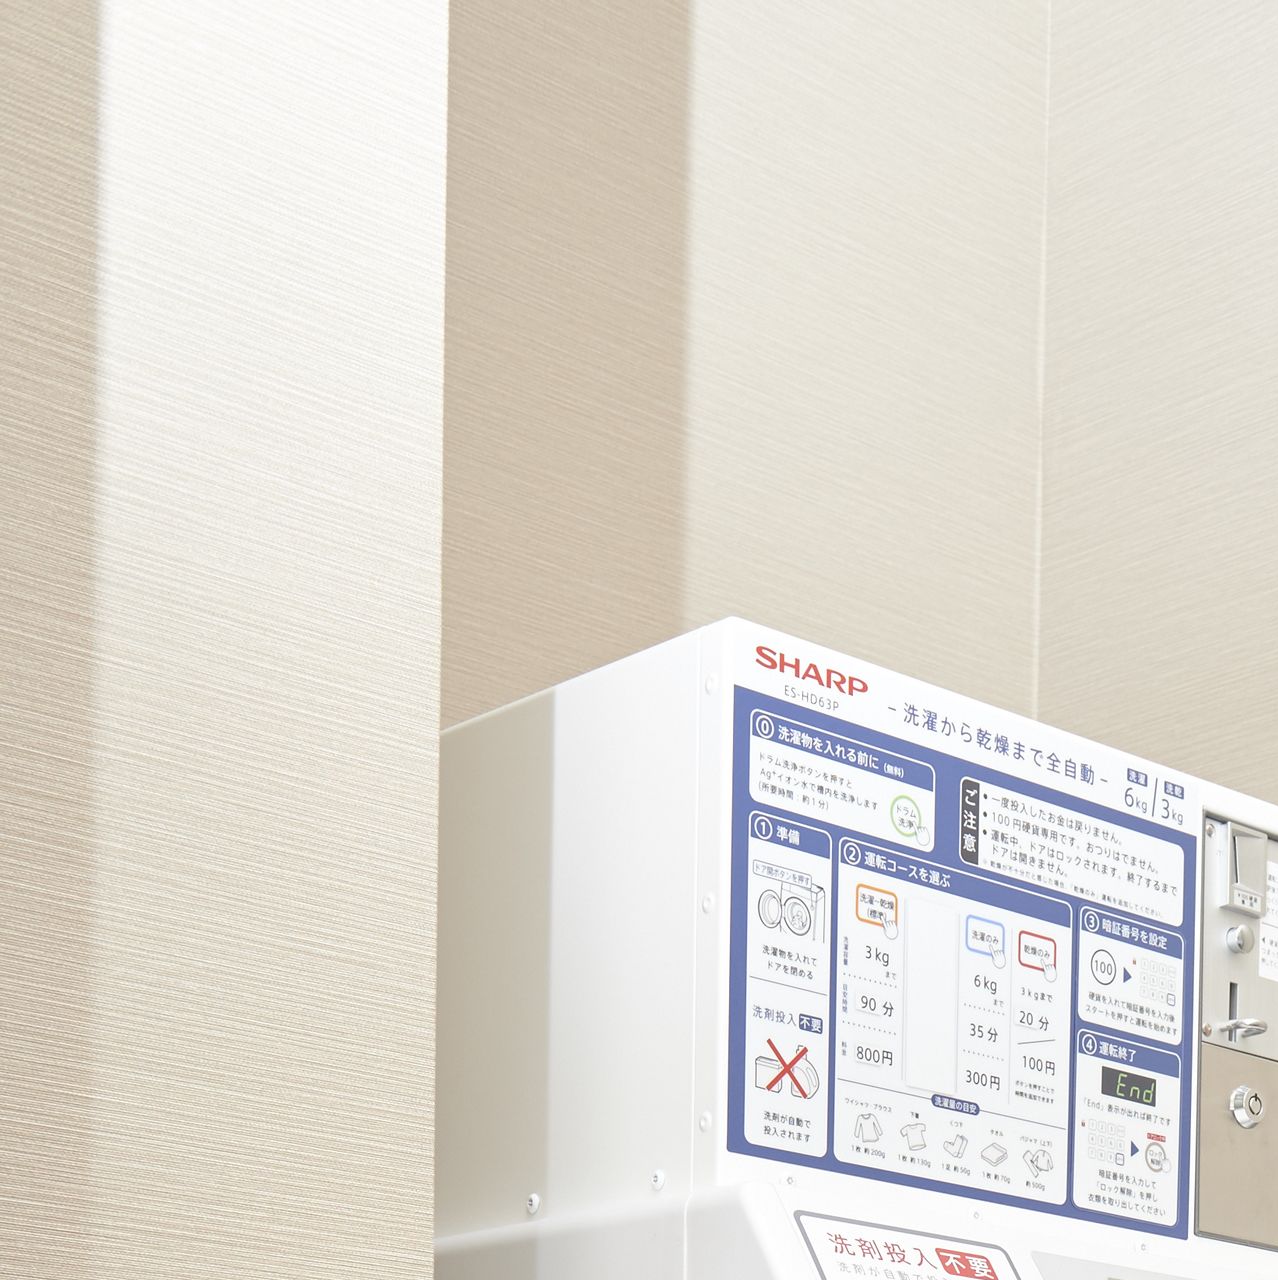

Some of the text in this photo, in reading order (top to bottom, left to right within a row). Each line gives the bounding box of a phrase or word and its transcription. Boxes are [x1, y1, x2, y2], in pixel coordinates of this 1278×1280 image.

[756, 646, 868, 696] SHARP
[784, 685, 839, 710] ES-HD63P
[759, 752, 853, 788] ドラム洗浄ボタンを押すと
[897, 807, 916, 818] ドラム
[963, 789, 977, 852] ご注意
[777, 826, 799, 845] 準備
[865, 852, 950, 887] 運転コースを選ぶ
[972, 930, 999, 945] 洗濯のみ
[1102, 919, 1167, 949] 暗証番号を設定
[763, 945, 817, 966] 洗濯物を入れて
[1024, 945, 1050, 958] 乾燥のみ
[768, 961, 813, 979] ドアを閉める
[885, 972, 896, 980] まで
[1095, 960, 1112, 975] 100
[753, 1004, 822, 1033] 洗剤投入 不要
[1100, 1041, 1136, 1062] 運転終了
[1116, 1073, 1154, 1103] End
[764, 1111, 810, 1128] 洗剤が自動で
[764, 1126, 810, 1142] 投入されます
[1099, 1170, 1156, 1188] 暗証番号を入力して
[1088, 1194, 1165, 1216] 衣類を取り出してください
[827, 1232, 993, 1279] 洗剤投入 不要
